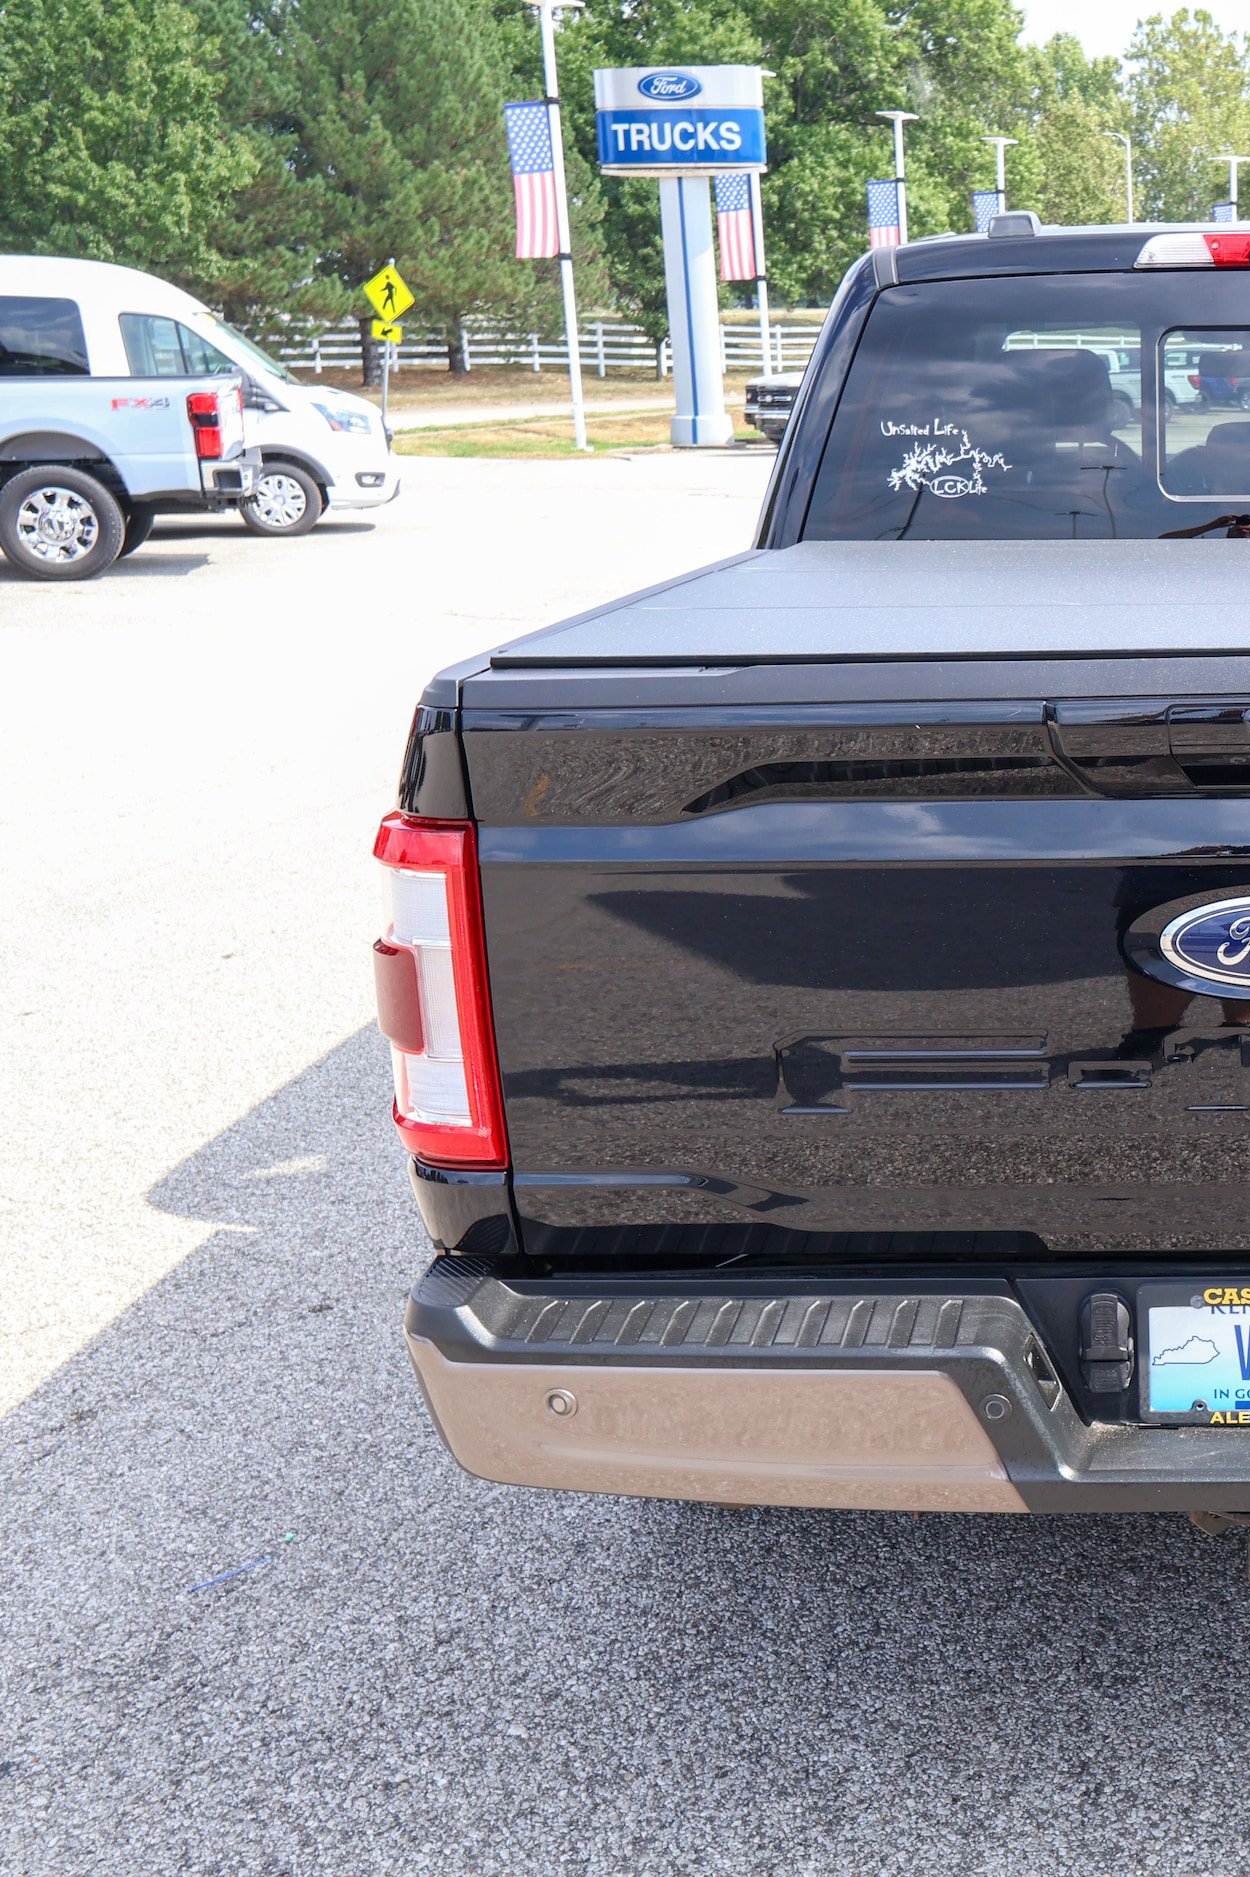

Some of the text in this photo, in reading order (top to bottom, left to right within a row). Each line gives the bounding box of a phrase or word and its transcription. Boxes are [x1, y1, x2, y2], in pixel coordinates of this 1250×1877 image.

[651, 76, 688, 95] Ford
[611, 121, 742, 151] TRUCKS
[111, 397, 170, 410] FX4
[1214, 1389, 1230, 1399] IN
